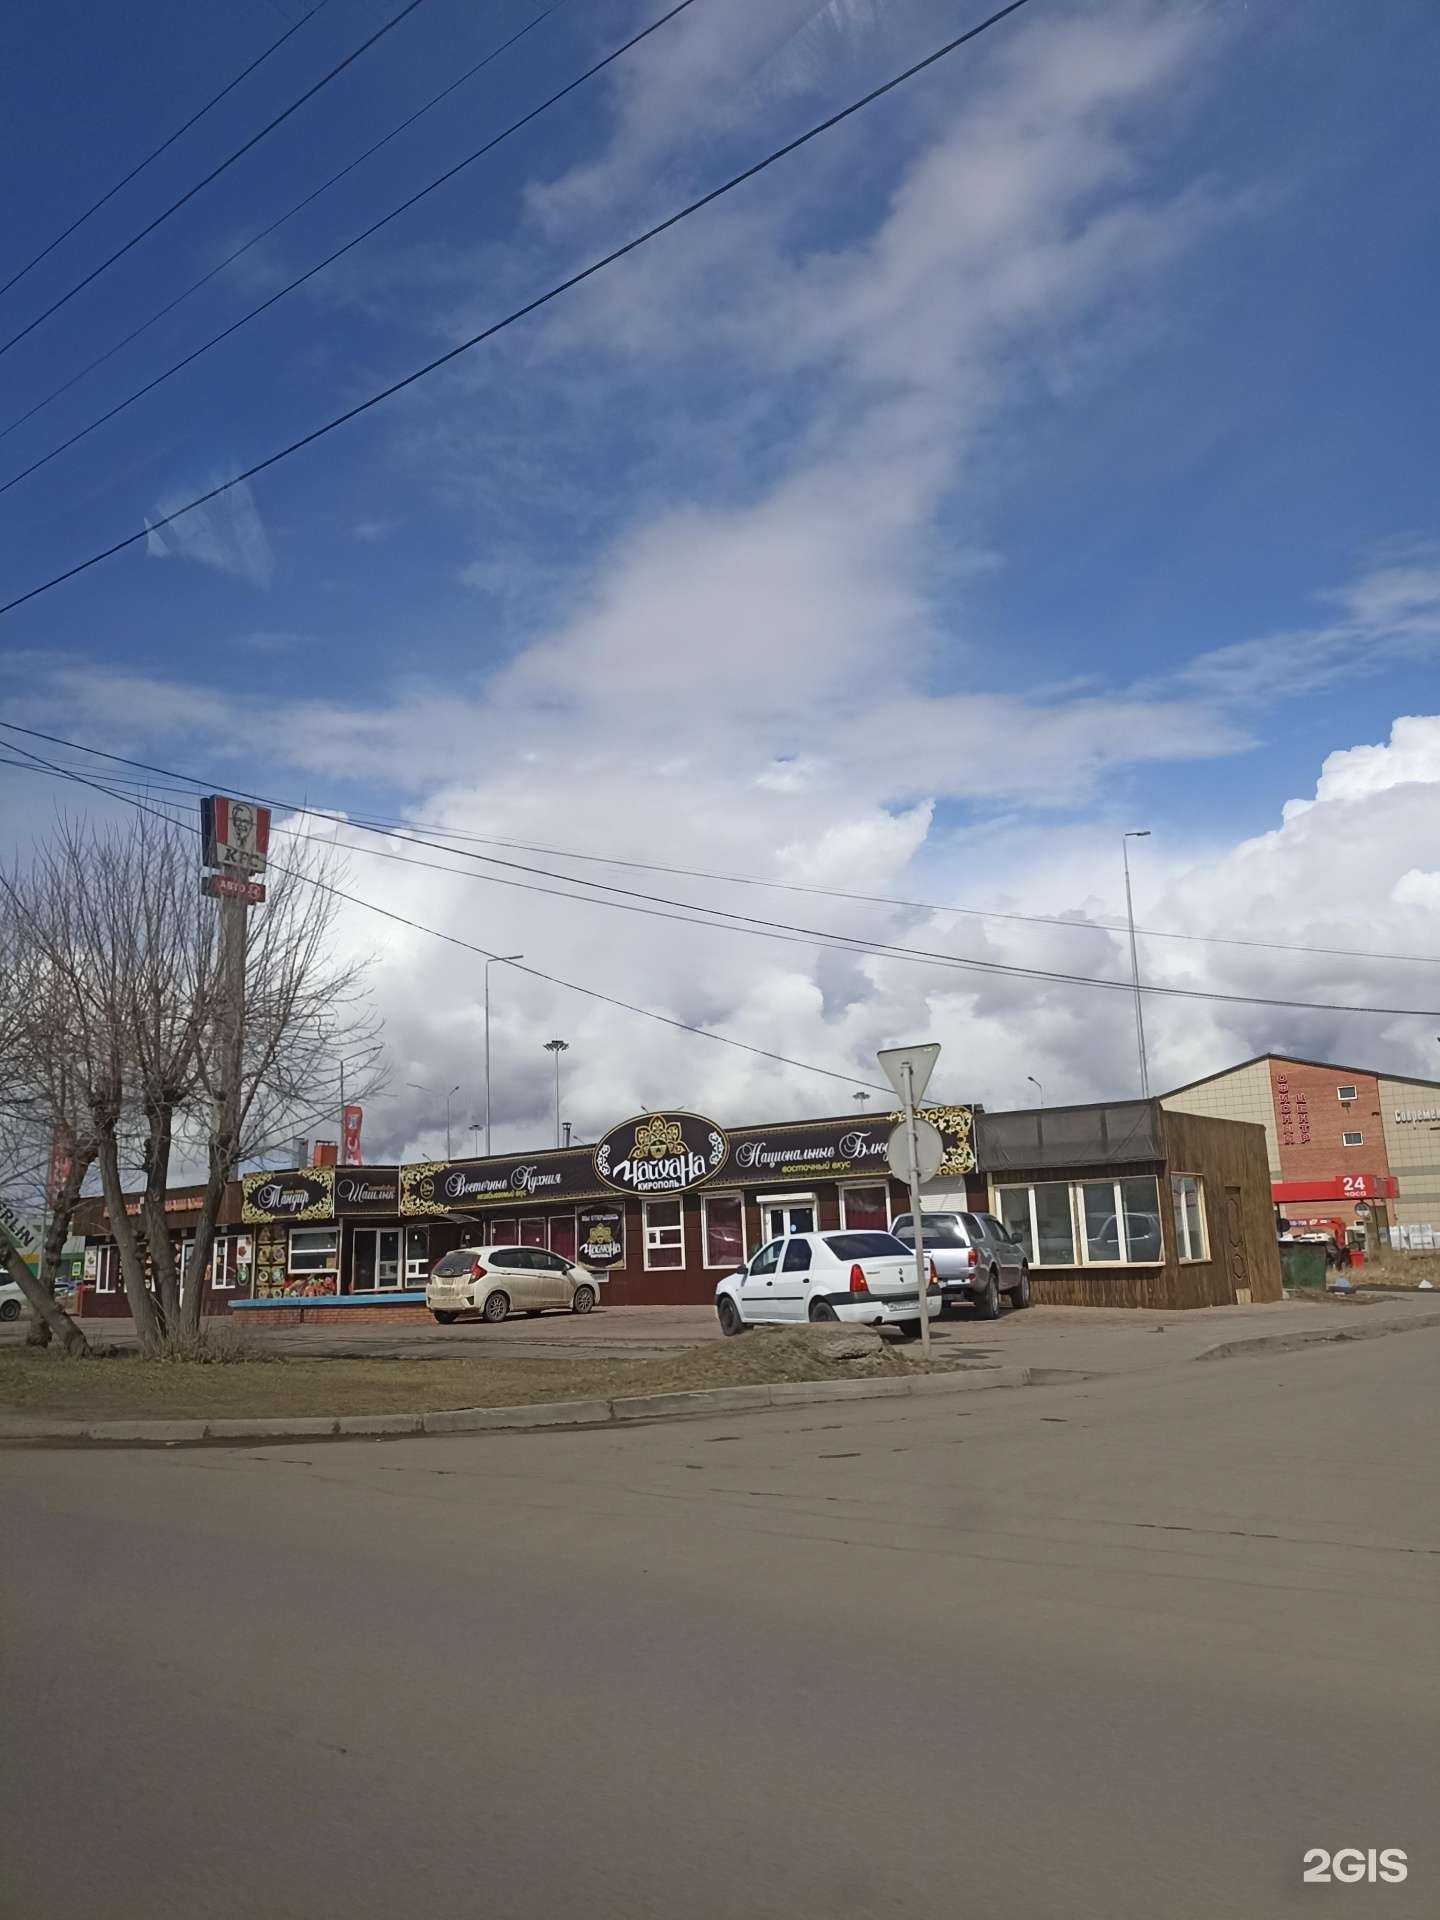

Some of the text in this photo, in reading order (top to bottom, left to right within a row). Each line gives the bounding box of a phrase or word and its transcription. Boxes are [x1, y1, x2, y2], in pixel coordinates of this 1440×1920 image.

[224, 847, 260, 868] KFC
[736, 1142, 835, 1168] Национальные
[613, 1152, 706, 1187] Чайхана
[638, 1179, 680, 1191] КИРОПОЛЬ
[1343, 1177, 1366, 1191] 24
